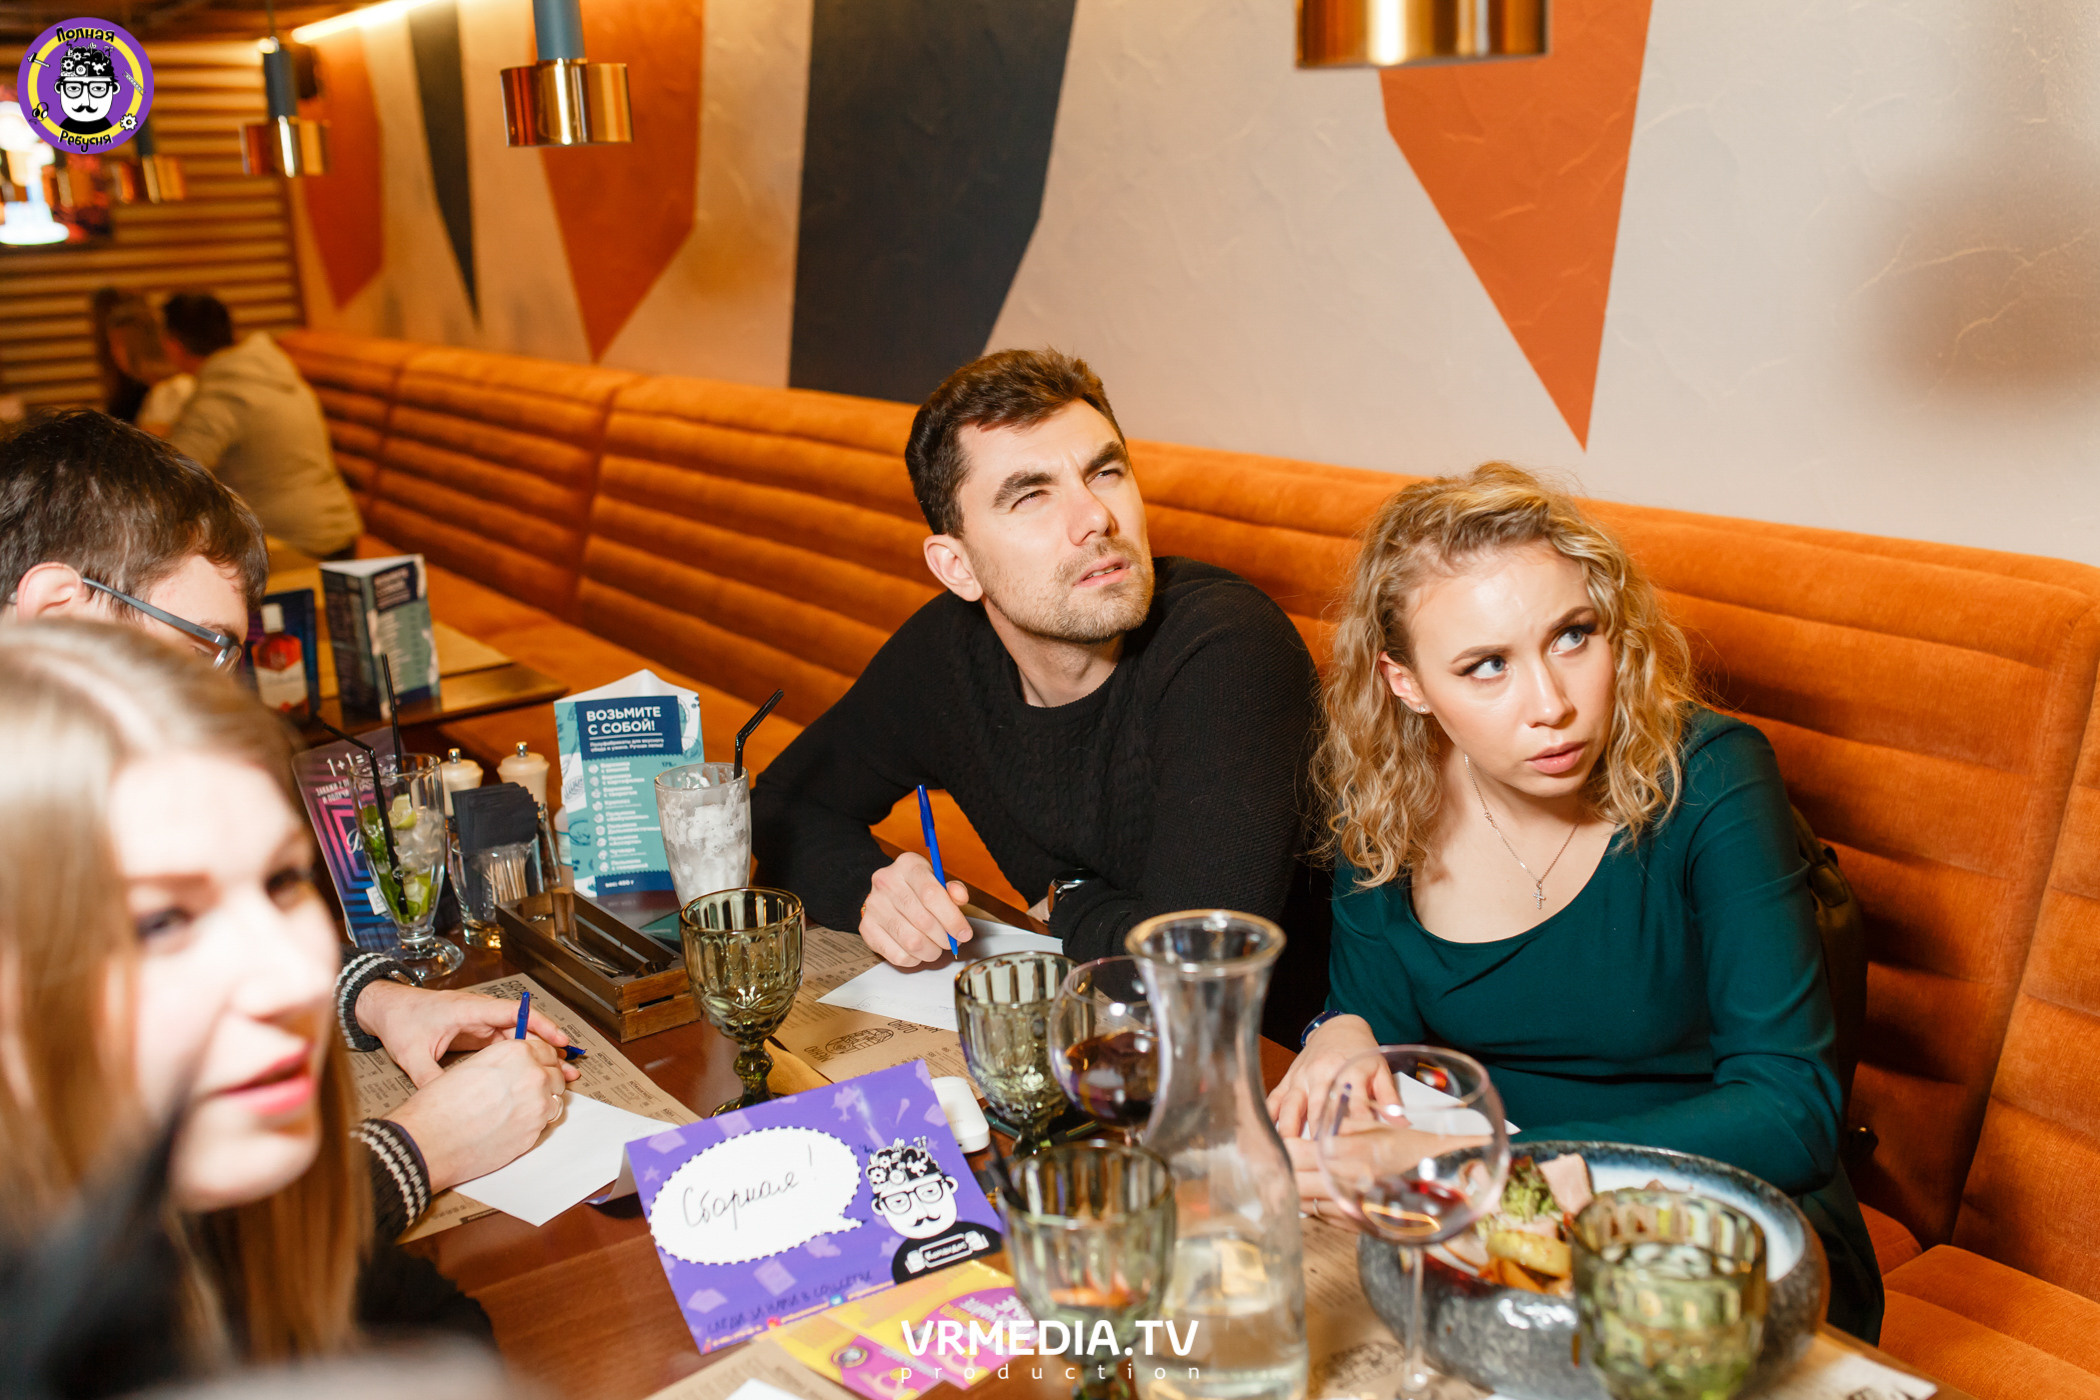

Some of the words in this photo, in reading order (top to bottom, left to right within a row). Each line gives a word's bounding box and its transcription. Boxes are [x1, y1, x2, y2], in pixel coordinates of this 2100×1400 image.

[586, 706, 661, 722] ВОЗЬМИТЕ
[588, 724, 598, 735] С
[601, 718, 655, 734] СОБОЙ!
